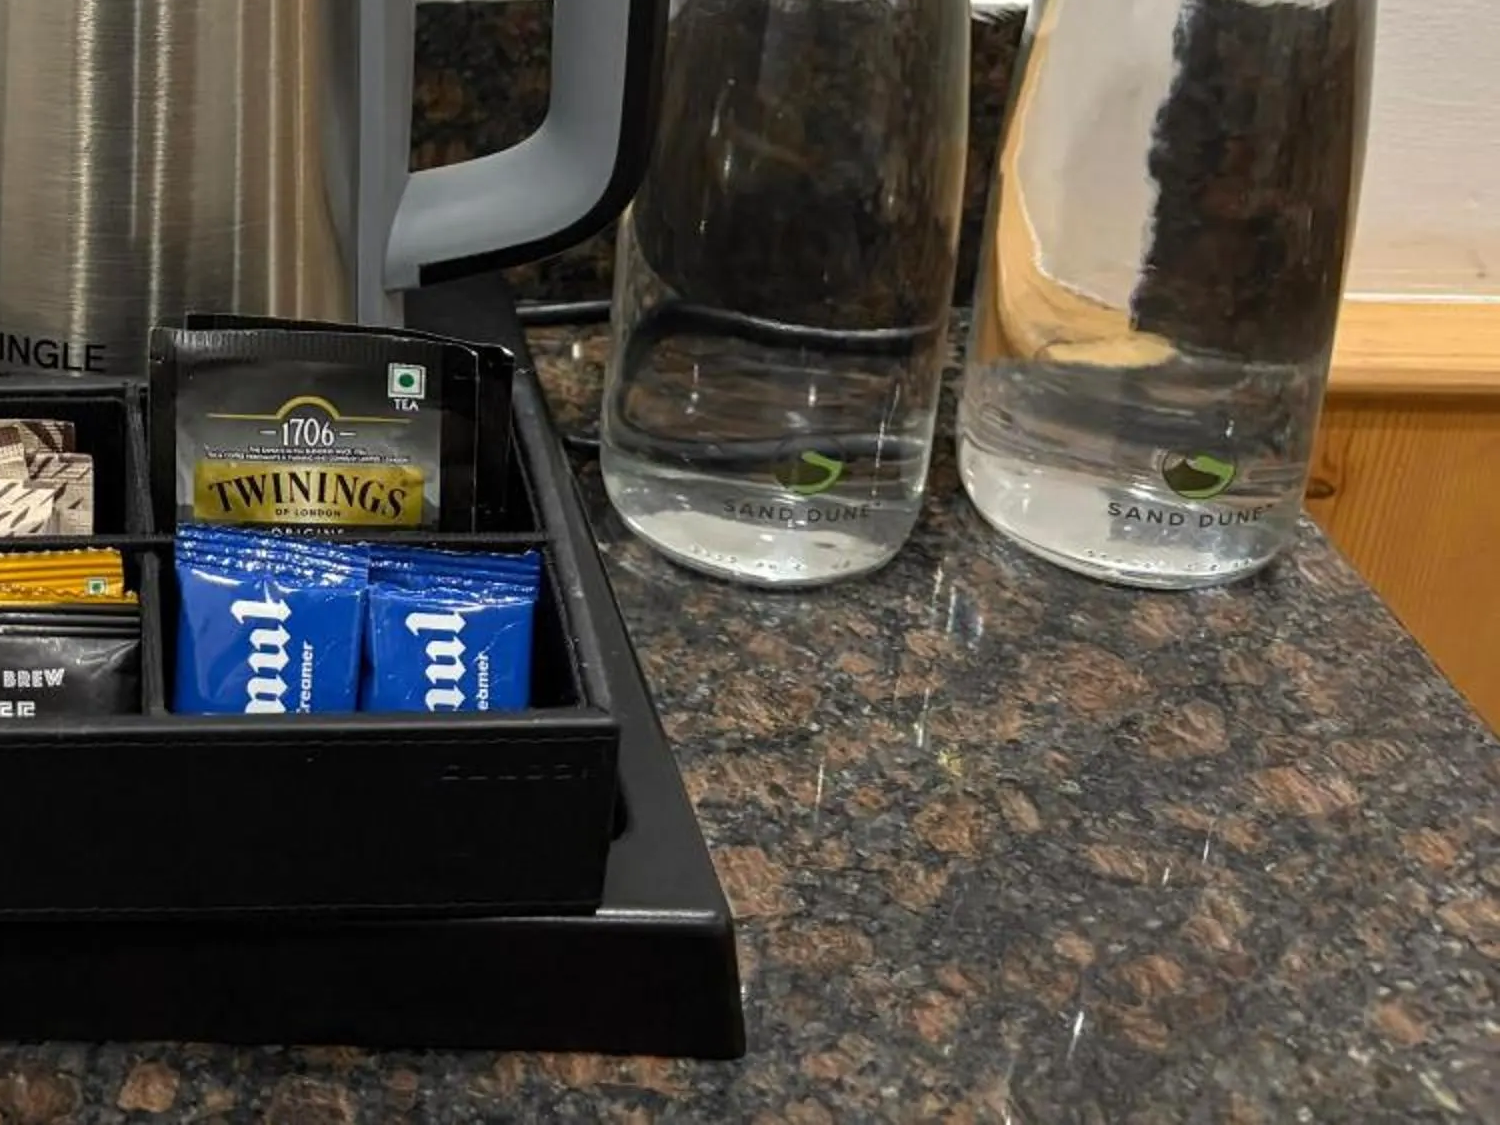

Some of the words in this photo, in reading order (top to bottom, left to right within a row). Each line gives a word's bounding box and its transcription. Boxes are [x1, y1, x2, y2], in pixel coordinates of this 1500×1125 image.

[393, 398, 420, 412] TEA
[281, 418, 336, 446] 1706
[208, 470, 407, 521] TWININGS
[275, 507, 291, 517] OF
[294, 508, 341, 519] LONDON
[723, 498, 795, 522] SAND
[807, 504, 872, 523] DUNE
[1107, 502, 1186, 527] SAND
[1199, 506, 1265, 528] DUNE
[230, 598, 293, 714] mul
[3, 667, 66, 689] BREW
[296, 639, 315, 714] reamer
[475, 651, 490, 711] eamer
